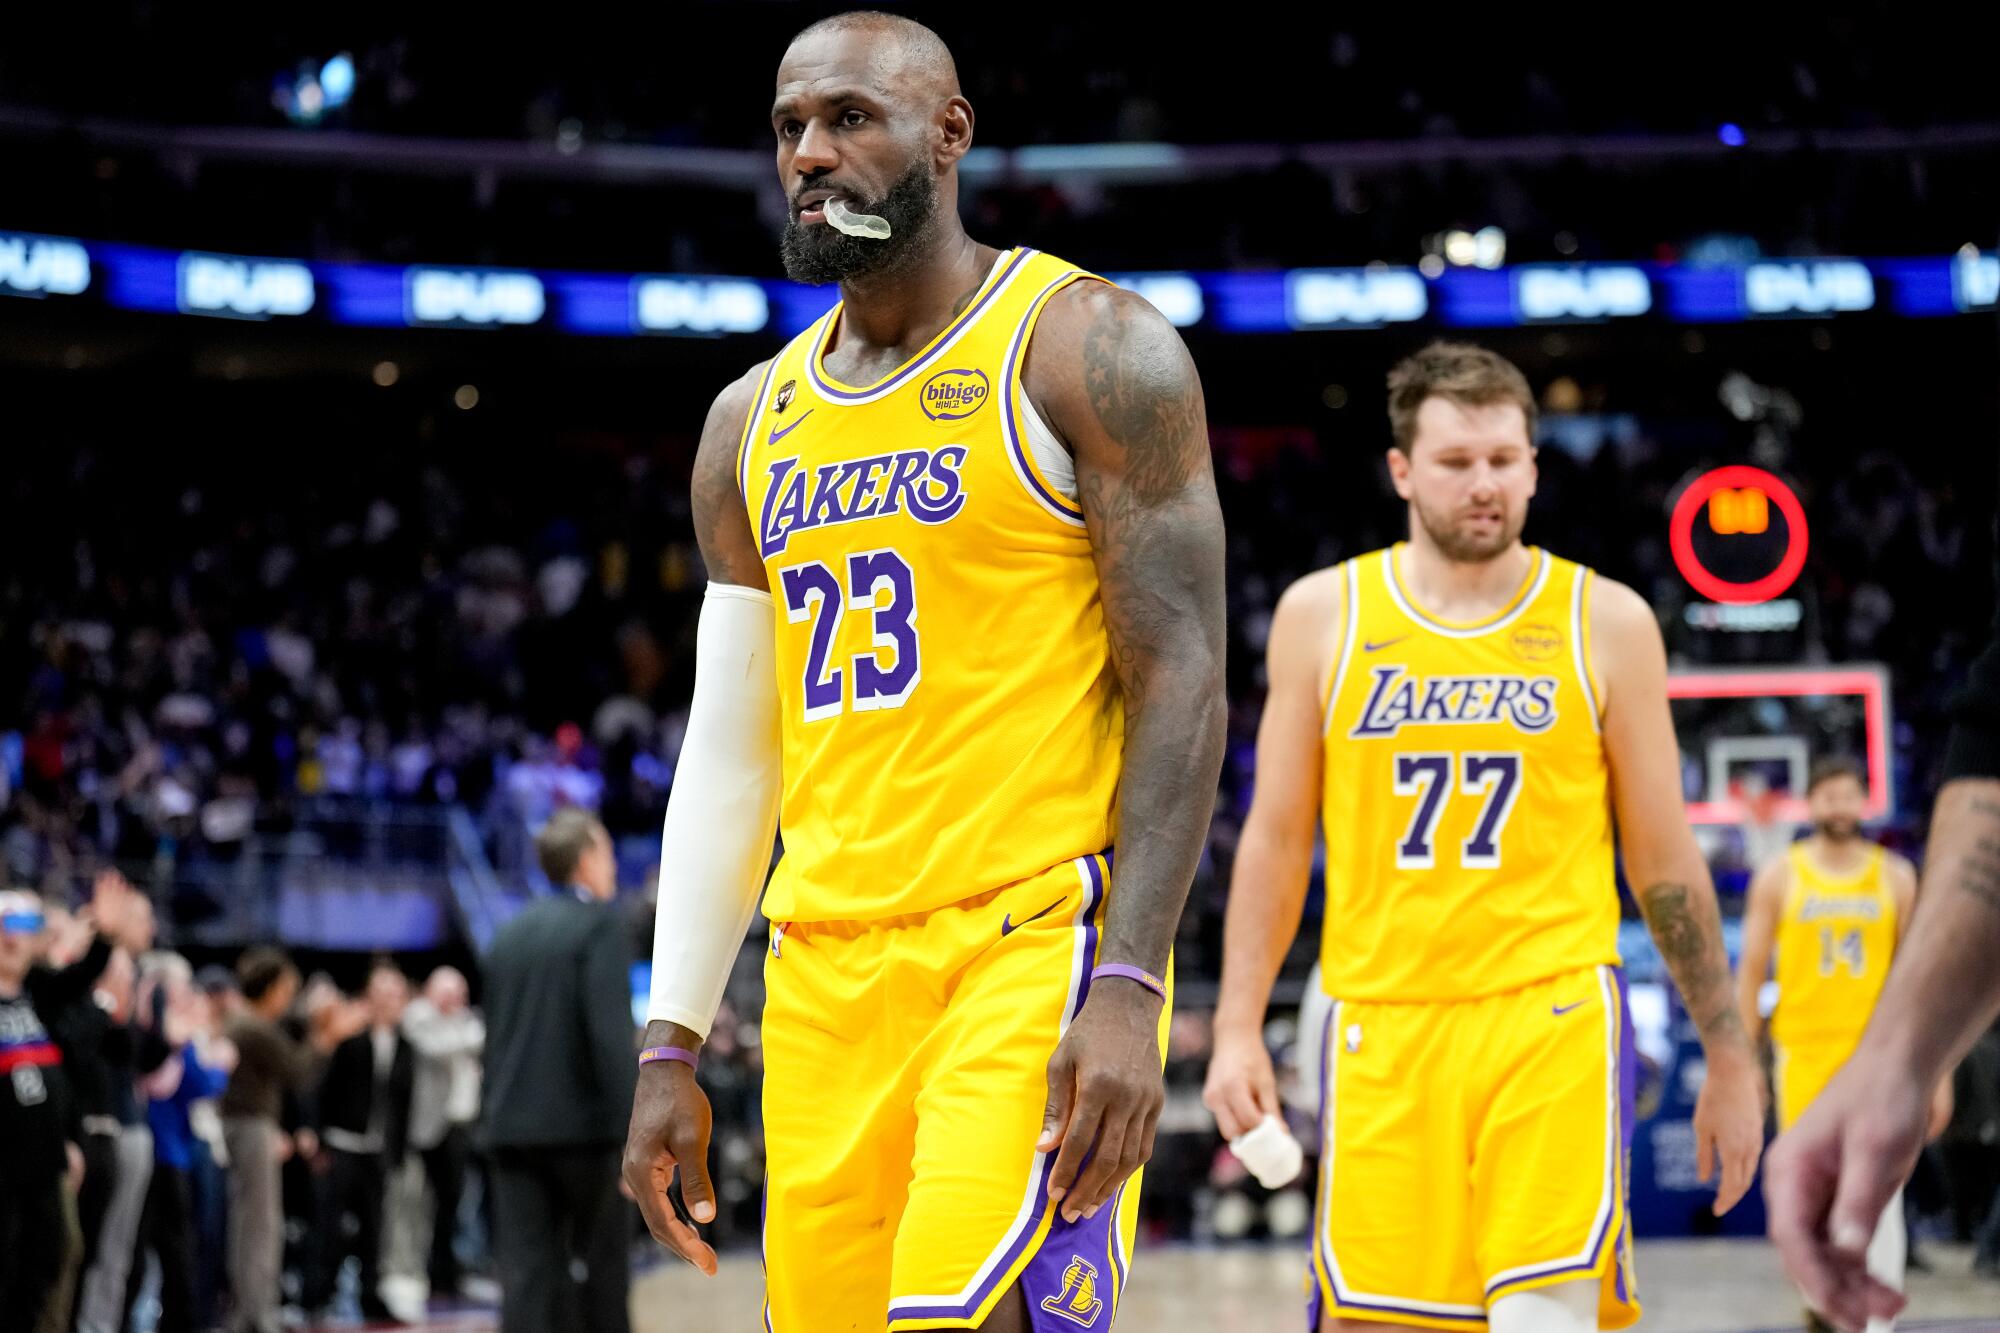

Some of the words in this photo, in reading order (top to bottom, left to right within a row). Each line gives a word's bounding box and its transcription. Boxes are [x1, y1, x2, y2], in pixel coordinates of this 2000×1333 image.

[927, 382, 985, 404] bibigo
[935, 400, 959, 410] 비비고
[760, 444, 969, 563] LAKERS
[779, 547, 921, 723] 23
[1348, 664, 1559, 740] LAKERS
[1392, 751, 1522, 869] 77
[1818, 927, 1867, 978] 14
